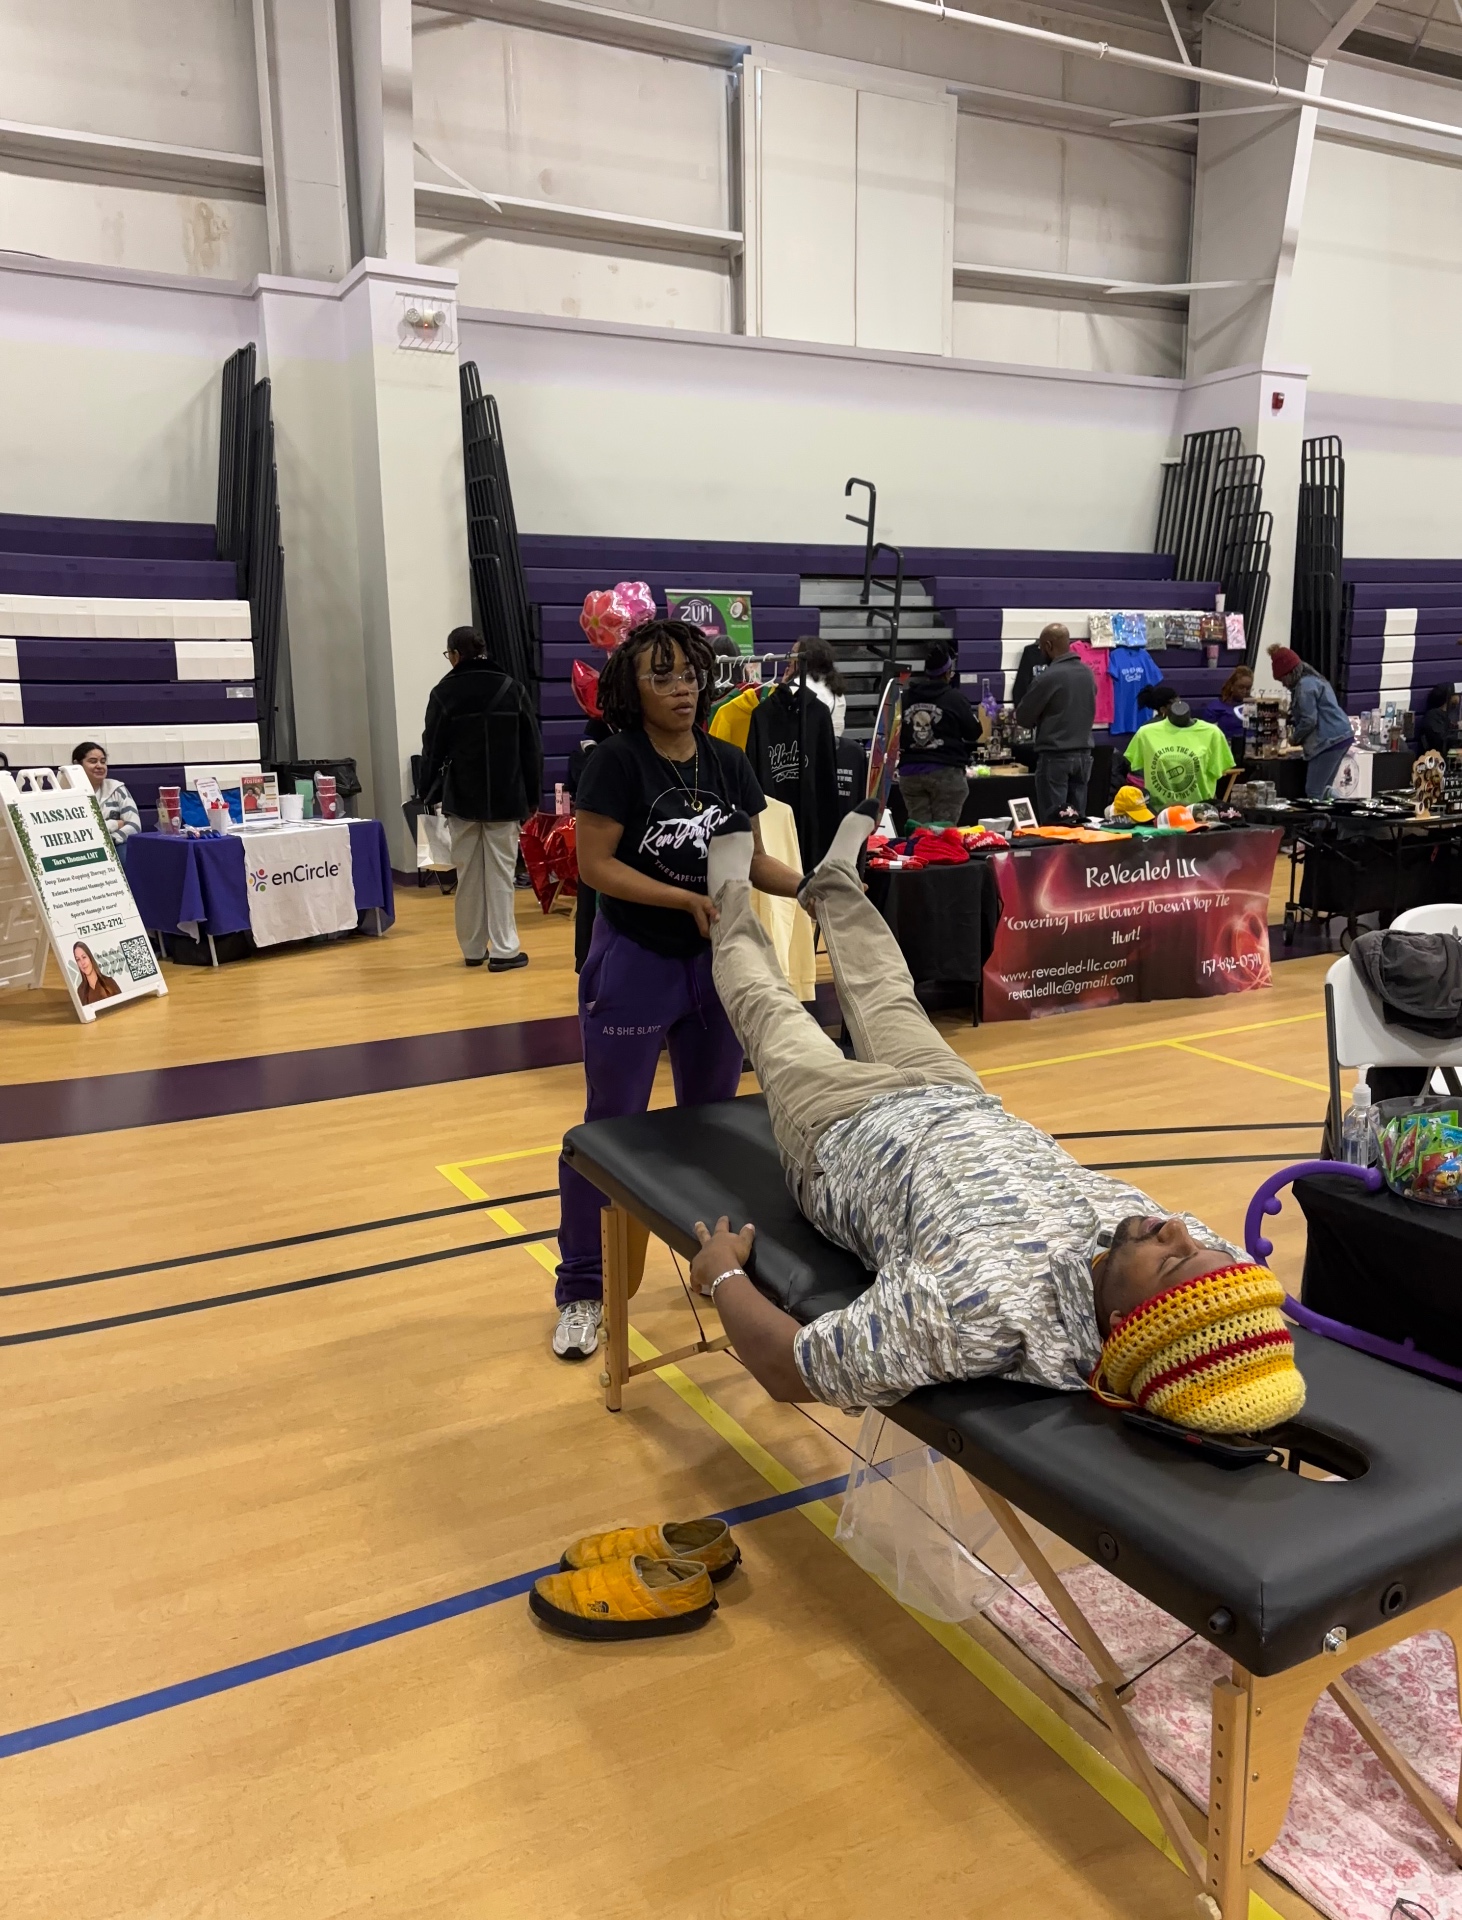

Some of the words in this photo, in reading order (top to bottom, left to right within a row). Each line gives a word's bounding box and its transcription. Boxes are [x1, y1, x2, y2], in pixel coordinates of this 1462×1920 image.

[1176, 746, 1190, 755] THE
[29, 806, 88, 825] MASSAGE
[40, 828, 94, 848] THERAPY
[271, 861, 339, 886] enCircle
[654, 859, 707, 883] THERAPEUTI
[1086, 861, 1171, 888] ReVealed
[1177, 857, 1202, 877] LLC
[77, 916, 124, 936] 757-323-2712
[1073, 908, 1096, 925] The
[1000, 958, 1127, 983] www.revealed-llc.com
[1008, 974, 1134, 1001] revealedllc@gmail.com
[602, 1025, 615, 1035] AS
[616, 1026, 635, 1036] SHE
